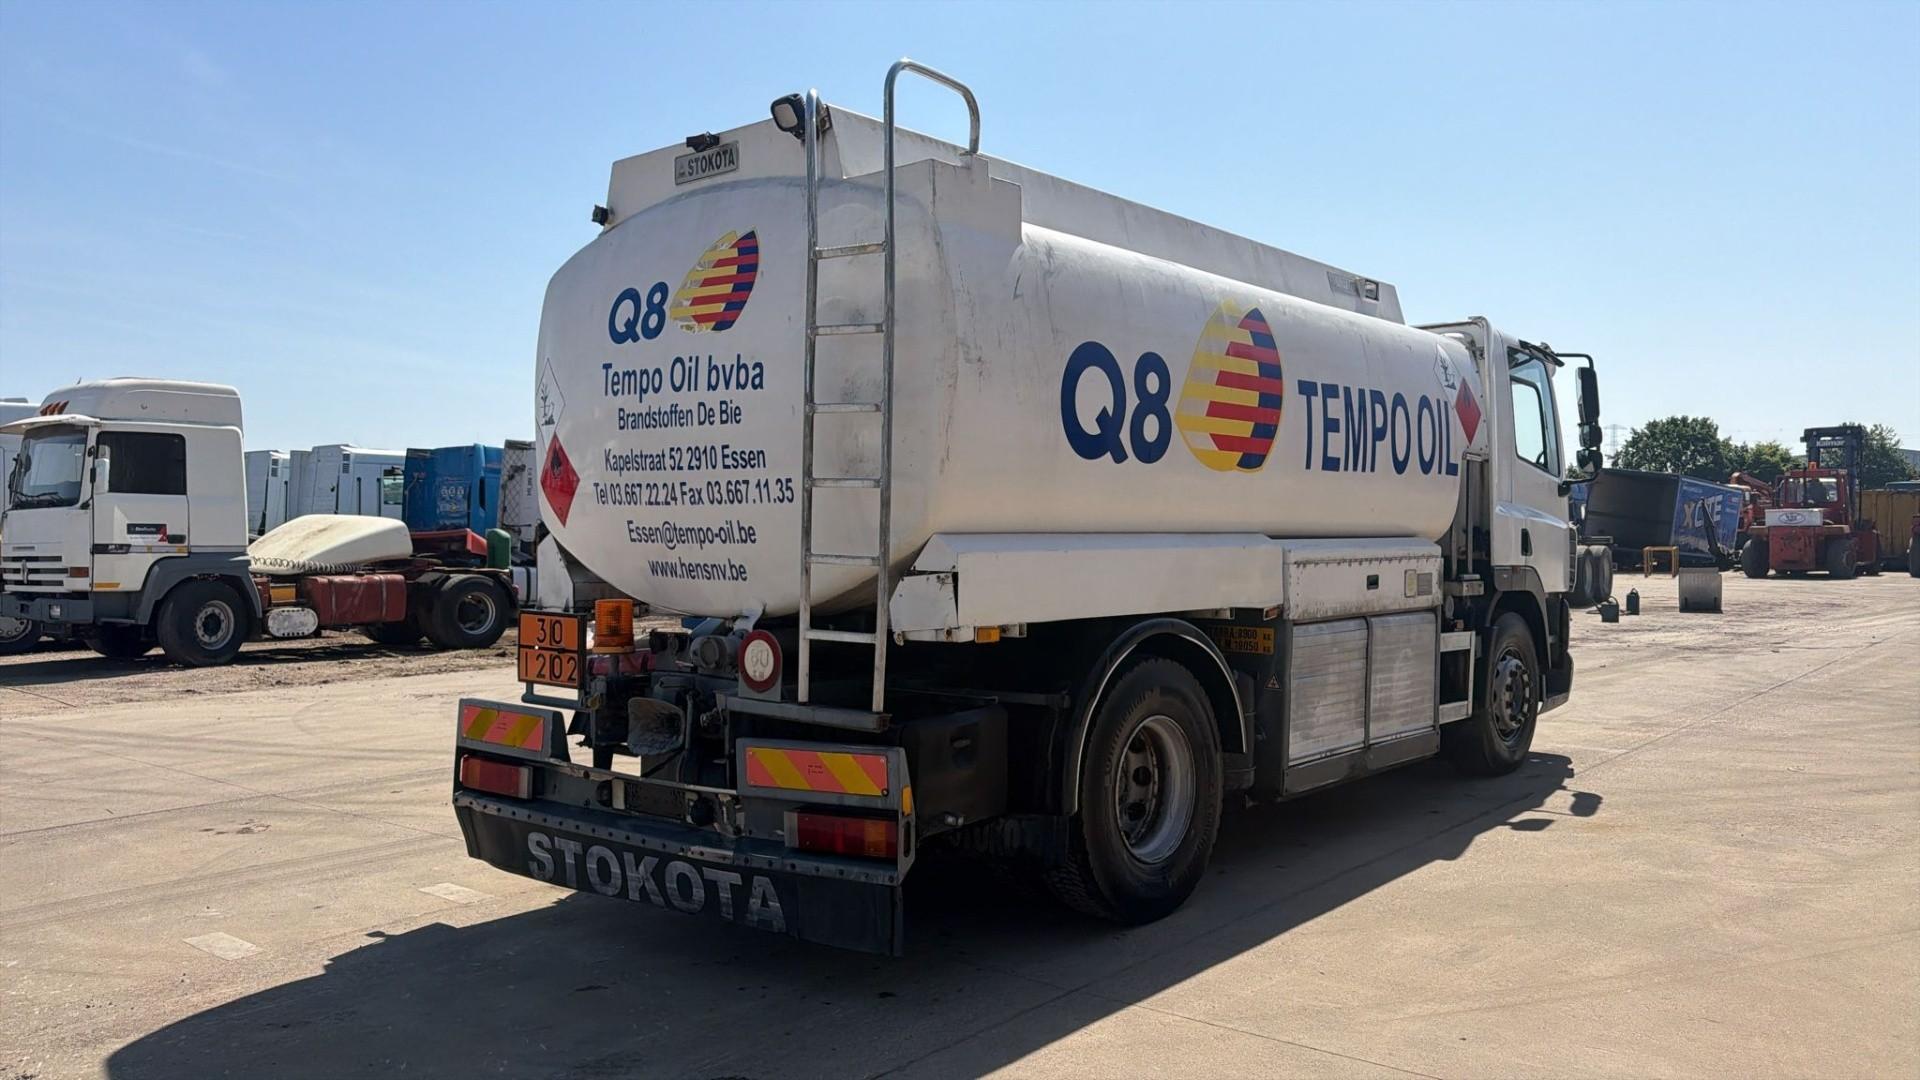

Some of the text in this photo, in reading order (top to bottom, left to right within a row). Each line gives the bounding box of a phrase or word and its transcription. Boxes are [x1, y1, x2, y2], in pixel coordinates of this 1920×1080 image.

[687, 148, 735, 177] STOKOTA
[608, 281, 669, 345] Q8
[602, 353, 765, 403] Tempo Oil bvba
[617, 400, 742, 431] Brandstoffen De Bie
[1060, 340, 1173, 465] Q8
[1297, 379, 1459, 476] TEMPO OIL
[604, 444, 767, 477] Kapelstraat 52 2910 Essen
[593, 477, 795, 506] Tel 03.667.22.24 Fax 03.667.11.35
[626, 519, 757, 550] Essen@tempo-oil.be
[648, 556, 748, 582] www.hensnv.be
[536, 618, 563, 645] 30
[525, 651, 577, 682] 1202
[526, 830, 787, 933] STOKOTA
